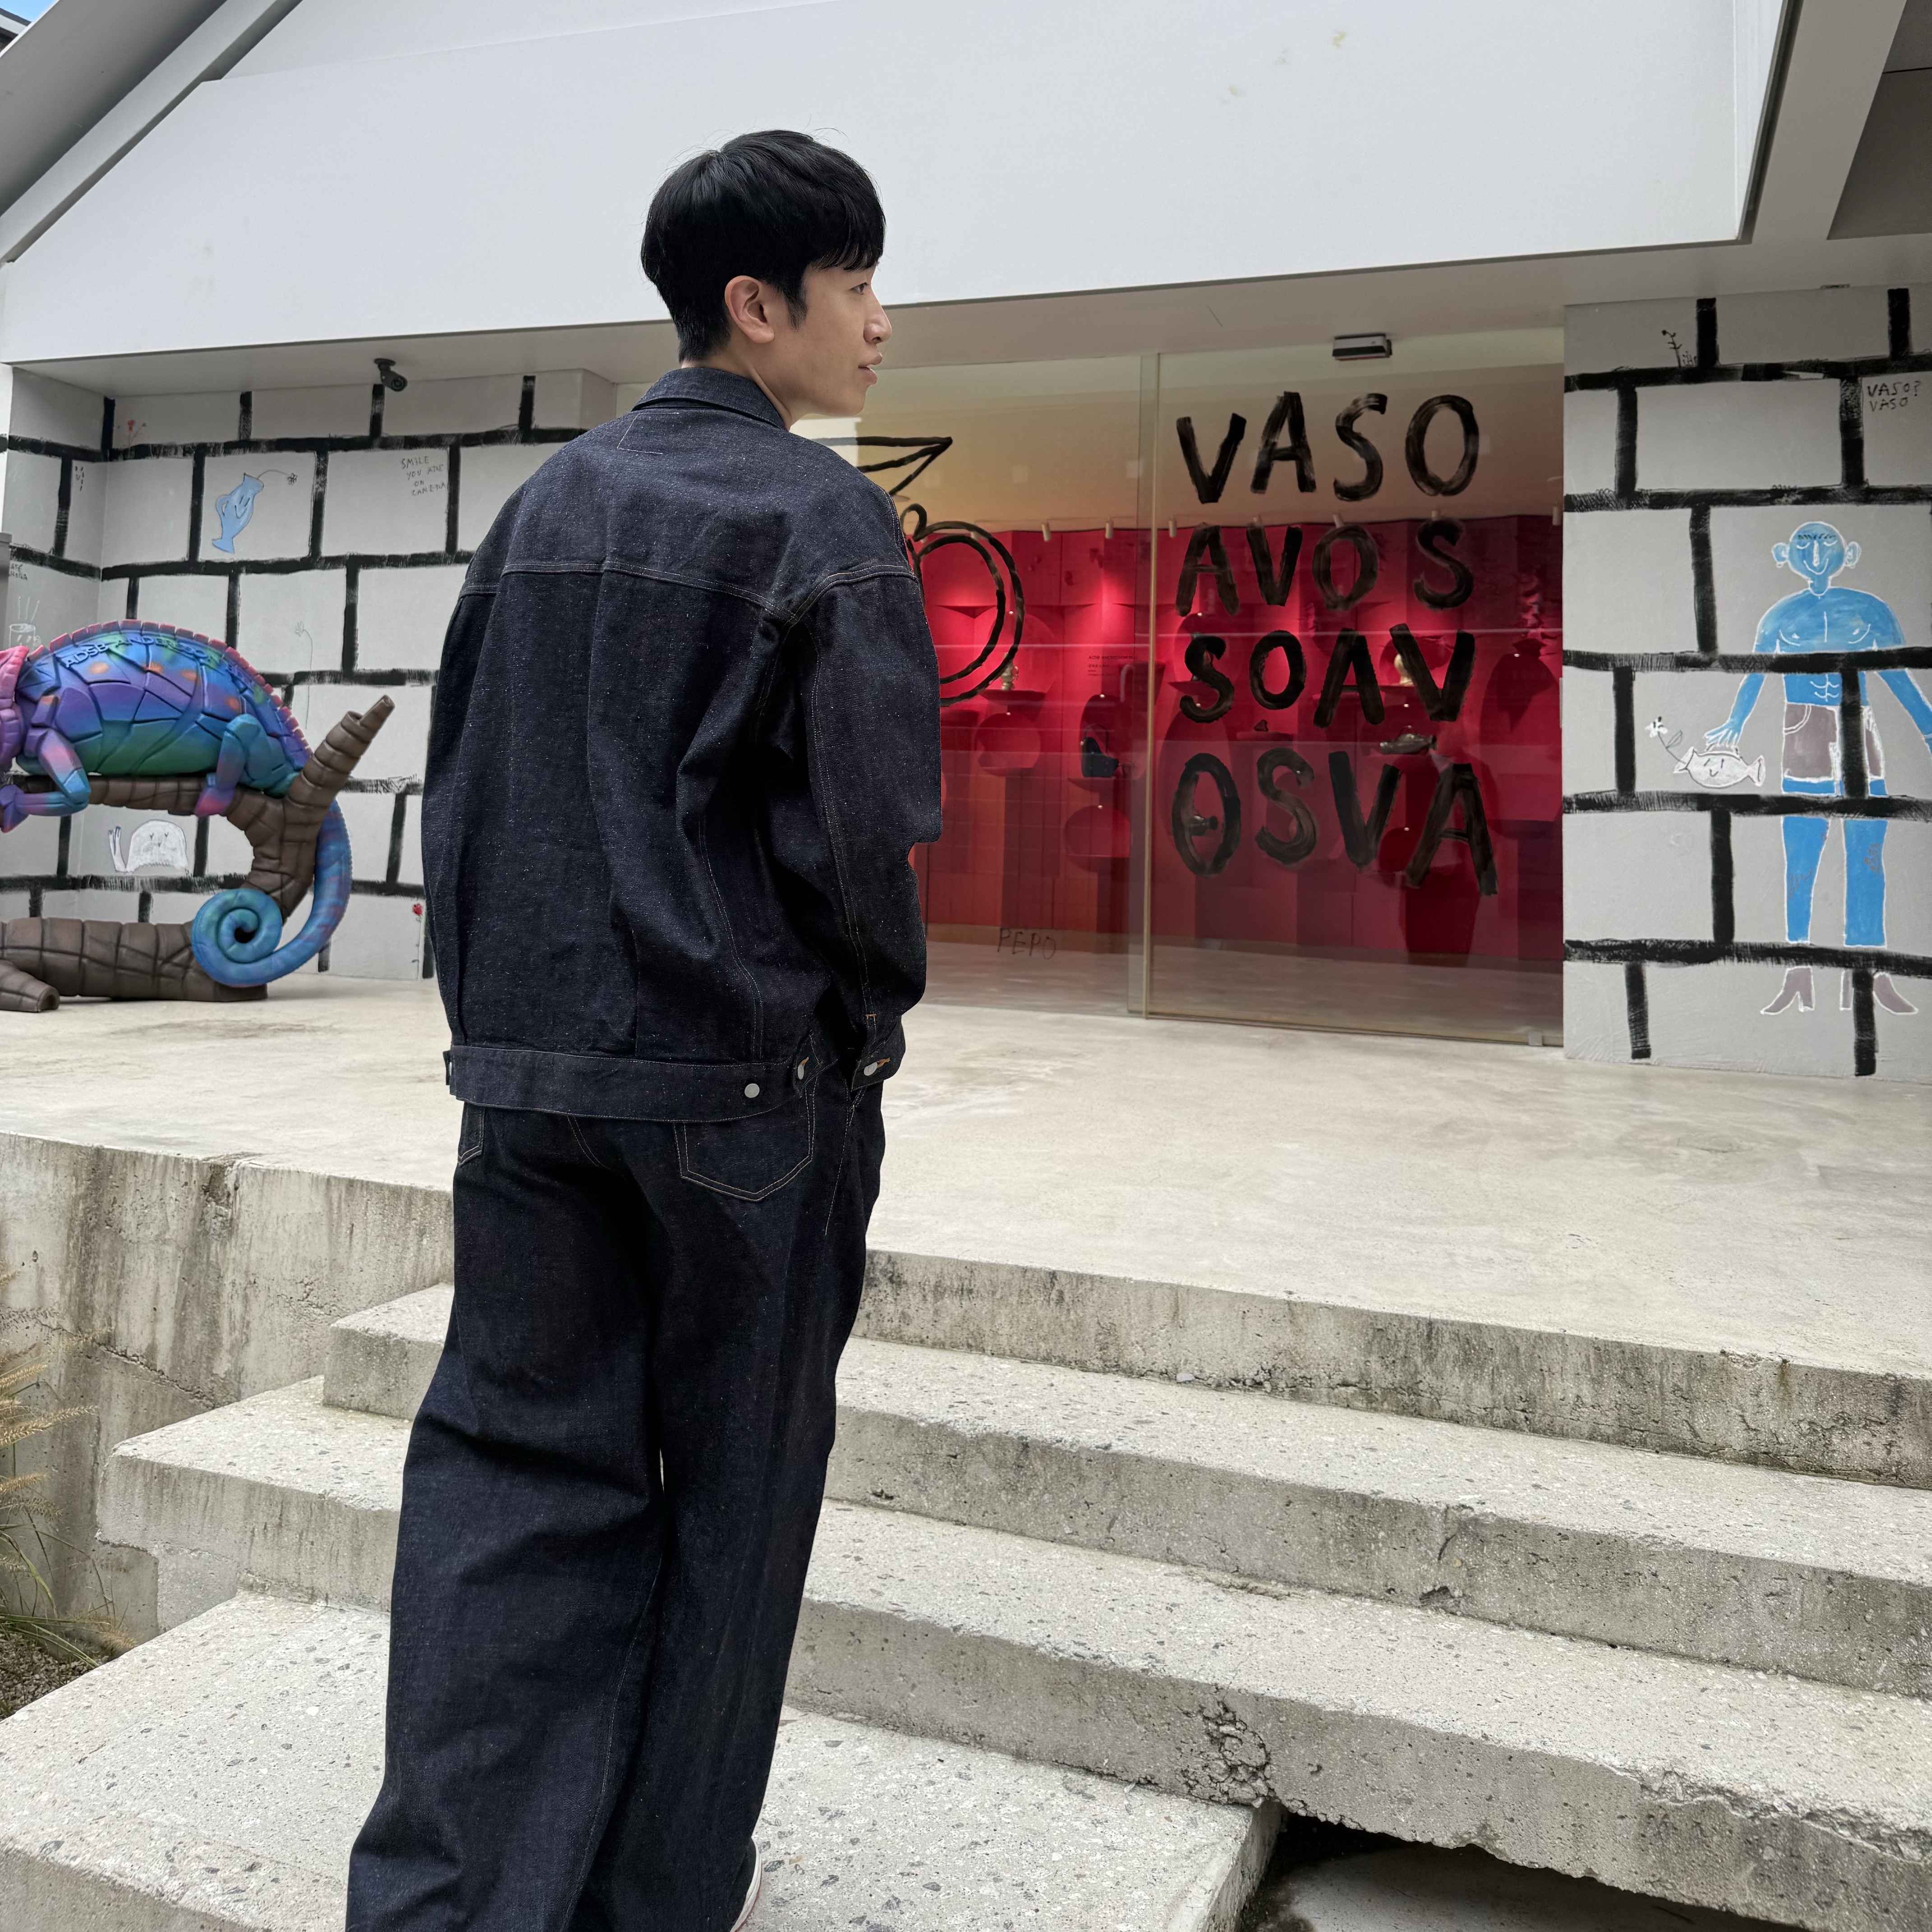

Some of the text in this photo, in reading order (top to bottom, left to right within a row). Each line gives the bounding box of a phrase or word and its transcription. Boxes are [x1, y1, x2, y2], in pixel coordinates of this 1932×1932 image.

[1869, 397, 1908, 412] VASO
[401, 456, 429, 469] SMILE
[1176, 391, 1480, 505] VASO
[407, 464, 444, 480] YOU ARE
[412, 482, 446, 496] CAMERA
[1175, 519, 1475, 617] AVOS
[65, 642, 109, 668] ADSB
[1179, 623, 1477, 728] SOAV
[1171, 748, 1498, 896] OSVA
[996, 927, 1057, 960] PEPO
